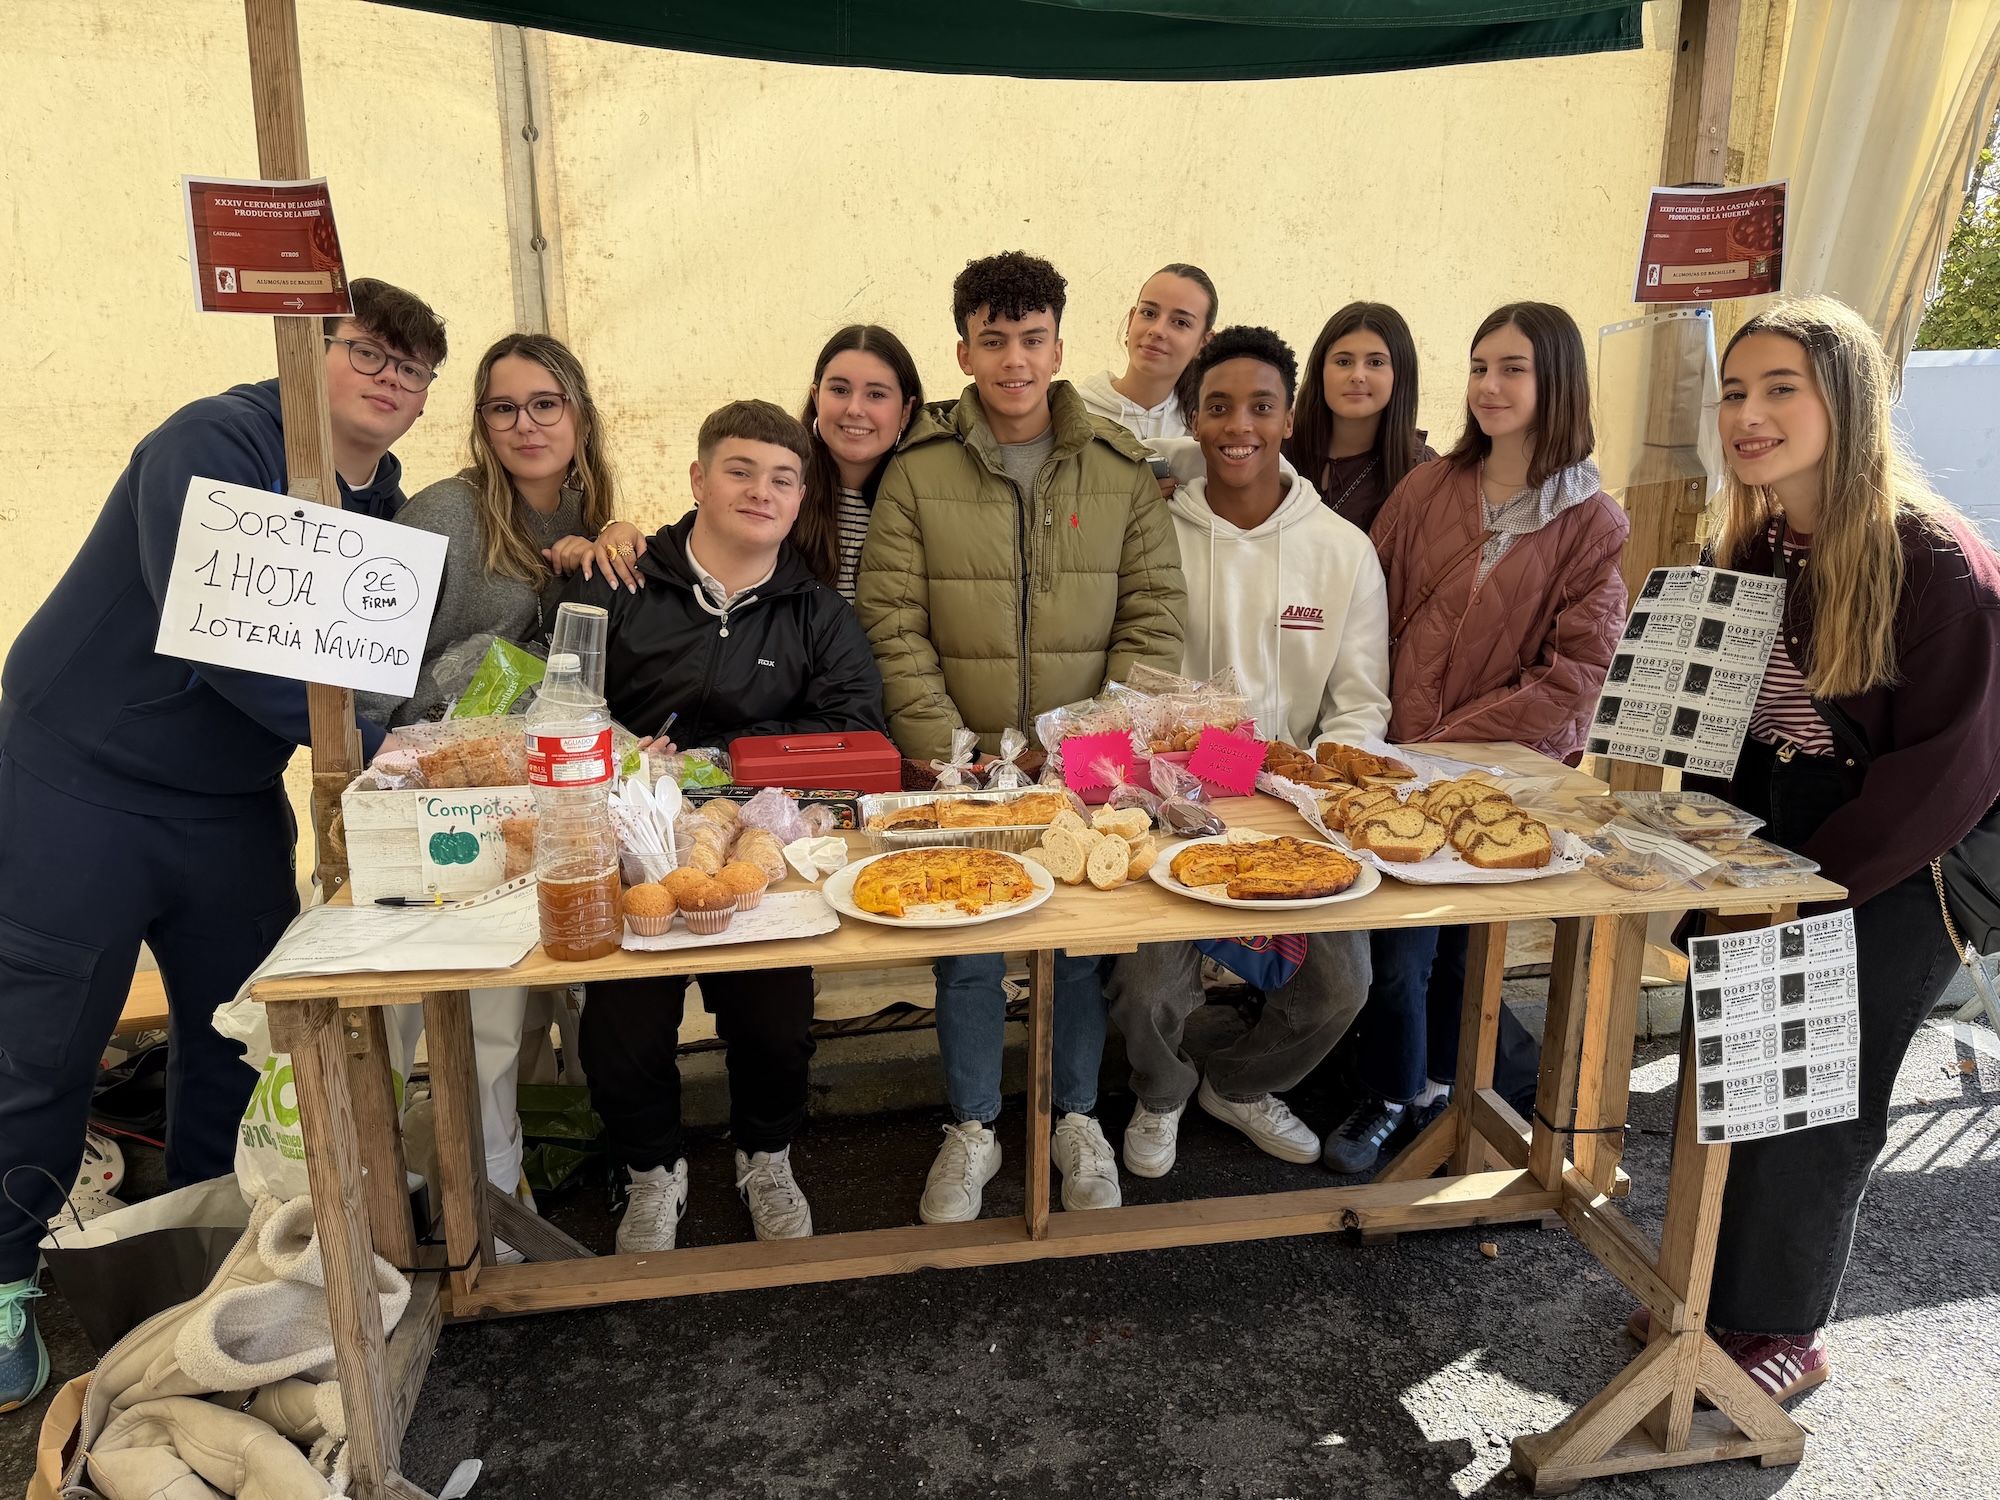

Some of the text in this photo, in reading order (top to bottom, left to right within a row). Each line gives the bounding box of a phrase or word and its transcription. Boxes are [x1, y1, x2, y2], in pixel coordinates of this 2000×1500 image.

[214, 198, 242, 206] XXXIV
[244, 200, 286, 209] CERTAMEN
[1726, 200, 1759, 210] CASTAÑA
[234, 208, 282, 218] PRODUCTOS
[1712, 212, 1720, 220] LA
[1722, 210, 1750, 218] HUERTA
[201, 490, 363, 558] SORTEO
[195, 550, 316, 606] 1 HOJA
[1739, 579, 1777, 592] 00813
[1282, 605, 1323, 618] ANGEL
[1649, 614, 1681, 623] 00813
[1726, 625, 1764, 637] 00813
[1635, 657, 1669, 667] 00813
[1714, 670, 1750, 682] 00813
[493, 680, 520, 715] SERVILLETA
[1622, 700, 1657, 710] 00813
[1701, 714, 1737, 725] 00813
[1610, 742, 1645, 754] 00813
[1688, 757, 1724, 769] 00813
[427, 796, 513, 825] Compota
[1807, 919, 1842, 932] 00813
[1722, 936, 1760, 949] 00813
[1808, 968, 1844, 981] 00813
[1724, 983, 1759, 996] 00813
[1808, 1015, 1845, 1028] 00813
[1725, 1030, 1761, 1043] 00813
[1809, 1061, 1844, 1074] 00813
[1726, 1076, 1762, 1089] 00813
[1810, 1105, 1845, 1118] 00813
[1727, 1121, 1763, 1133] 00813
